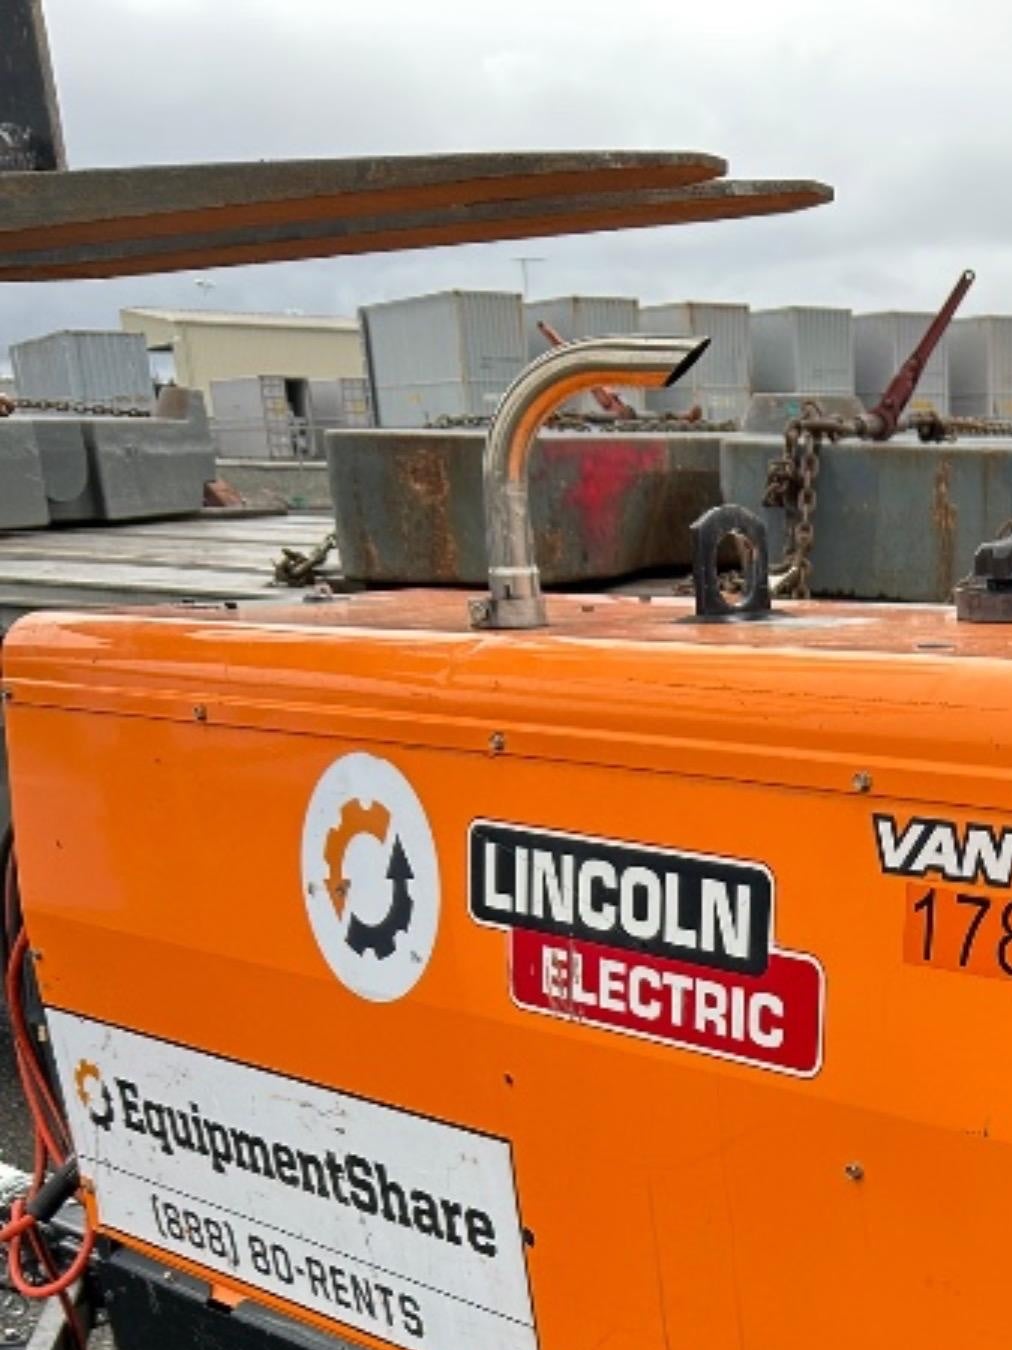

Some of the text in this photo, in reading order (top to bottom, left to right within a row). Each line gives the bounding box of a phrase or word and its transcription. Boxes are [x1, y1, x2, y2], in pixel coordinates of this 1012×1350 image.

[484, 841, 751, 960] LINCOLN
[541, 944, 785, 1049] ELECTRIC
[113, 1076, 499, 1258] EquipmentShare
[151, 1192, 425, 1340] (888) 80-RENTS
